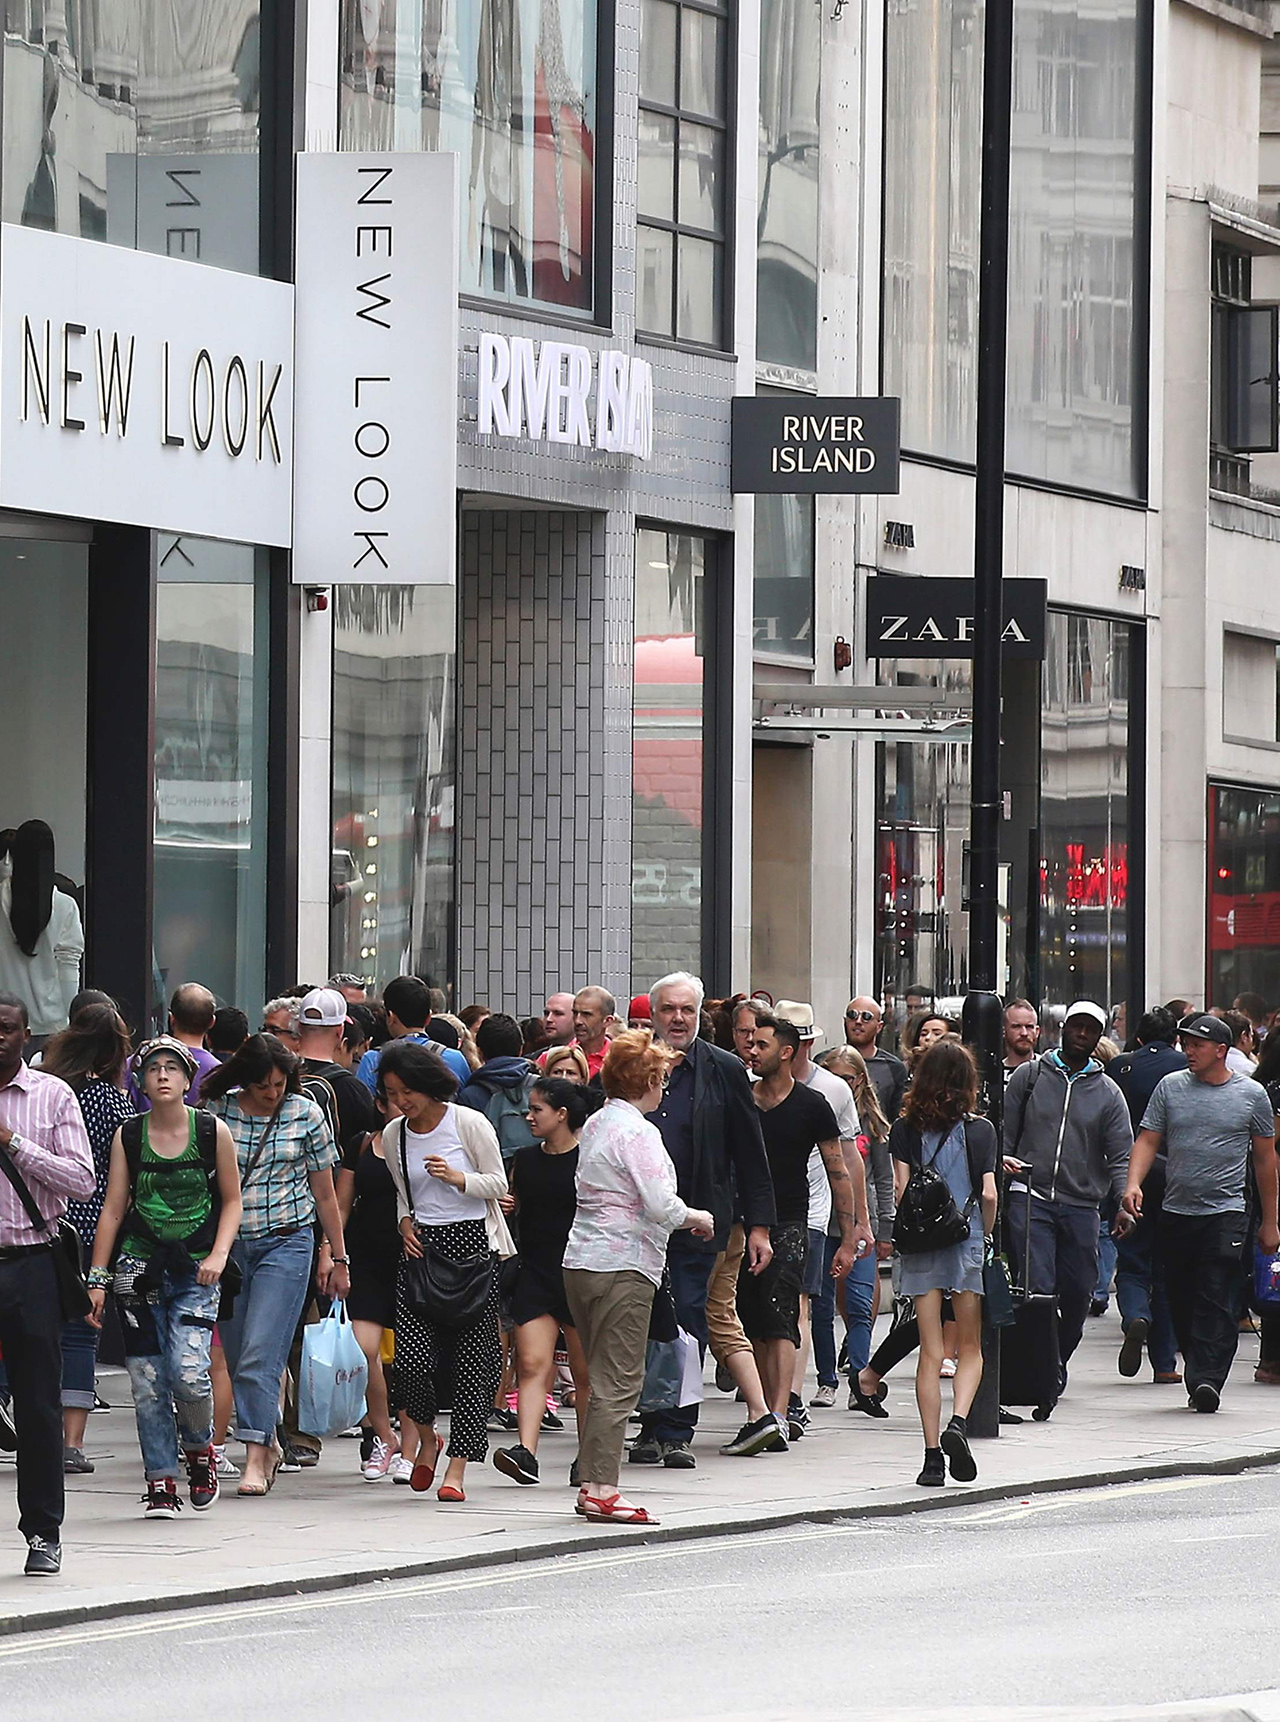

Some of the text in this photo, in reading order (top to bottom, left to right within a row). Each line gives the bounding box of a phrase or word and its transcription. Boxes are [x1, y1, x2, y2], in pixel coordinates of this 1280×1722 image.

[20, 315, 283, 465] NEW LOOK
[353, 168, 393, 570] NEW LOOK
[478, 333, 592, 448] RIVER
[772, 447, 876, 473] ISLAND
[783, 416, 865, 441] RIVER
[884, 521, 915, 548] ZARA
